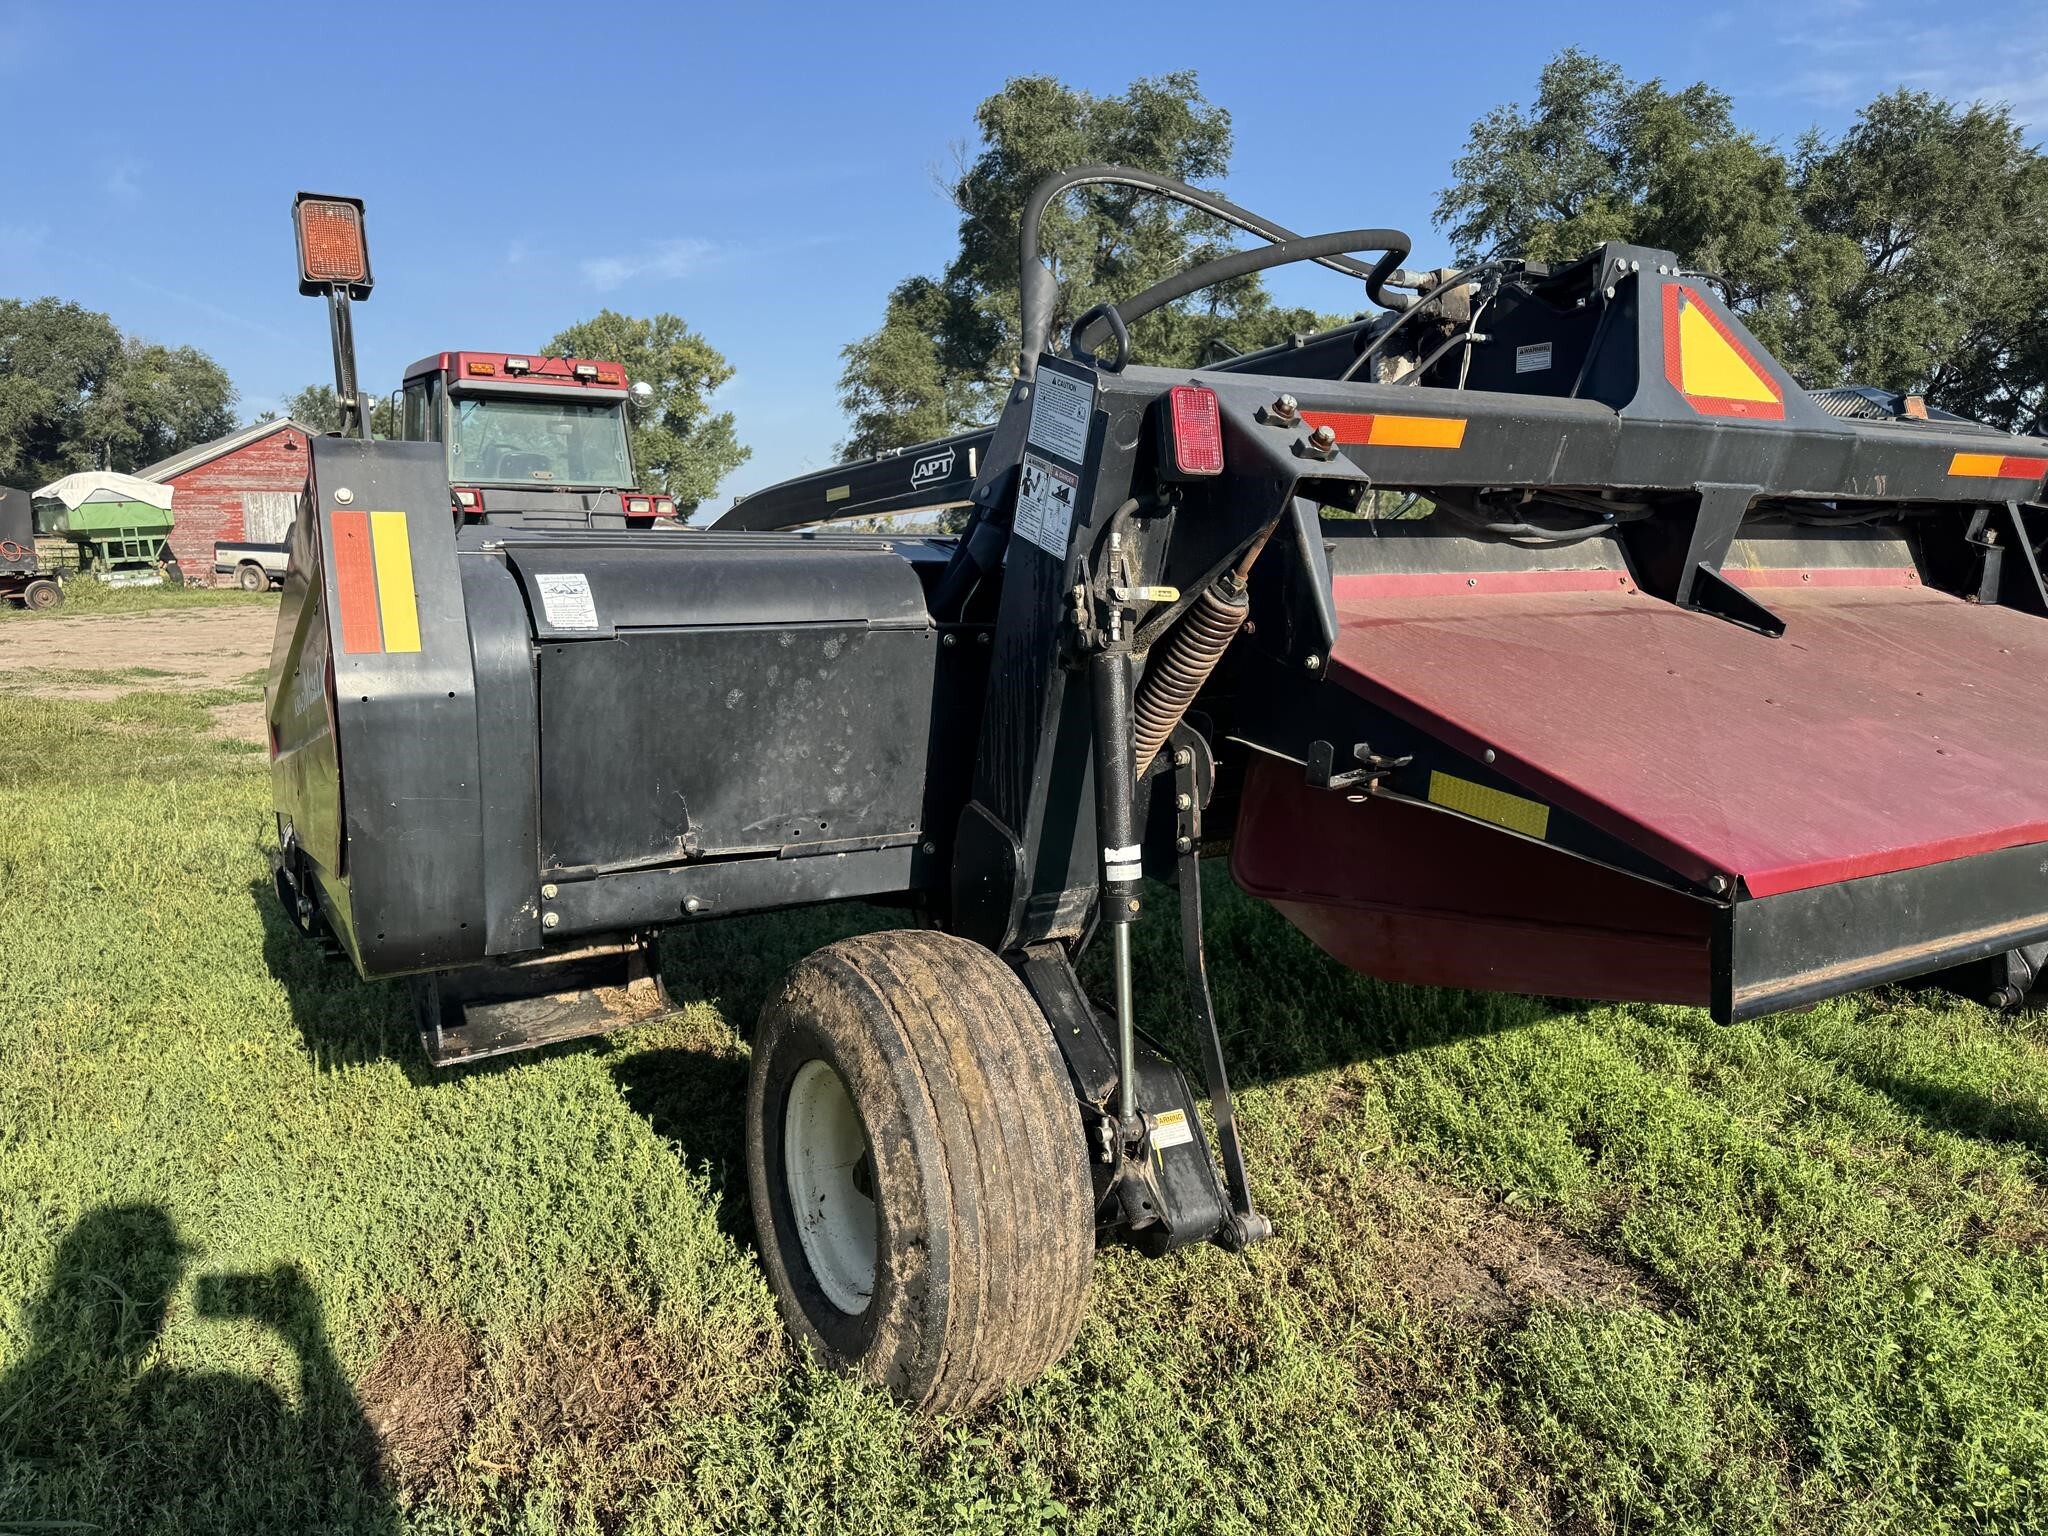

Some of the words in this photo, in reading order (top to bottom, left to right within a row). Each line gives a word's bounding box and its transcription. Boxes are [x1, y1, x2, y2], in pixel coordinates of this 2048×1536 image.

[1524, 345, 1550, 354] WARNING
[1057, 379, 1077, 392] CAUTION
[914, 458, 952, 478] APT
[1158, 1113, 1184, 1124] ARNING
